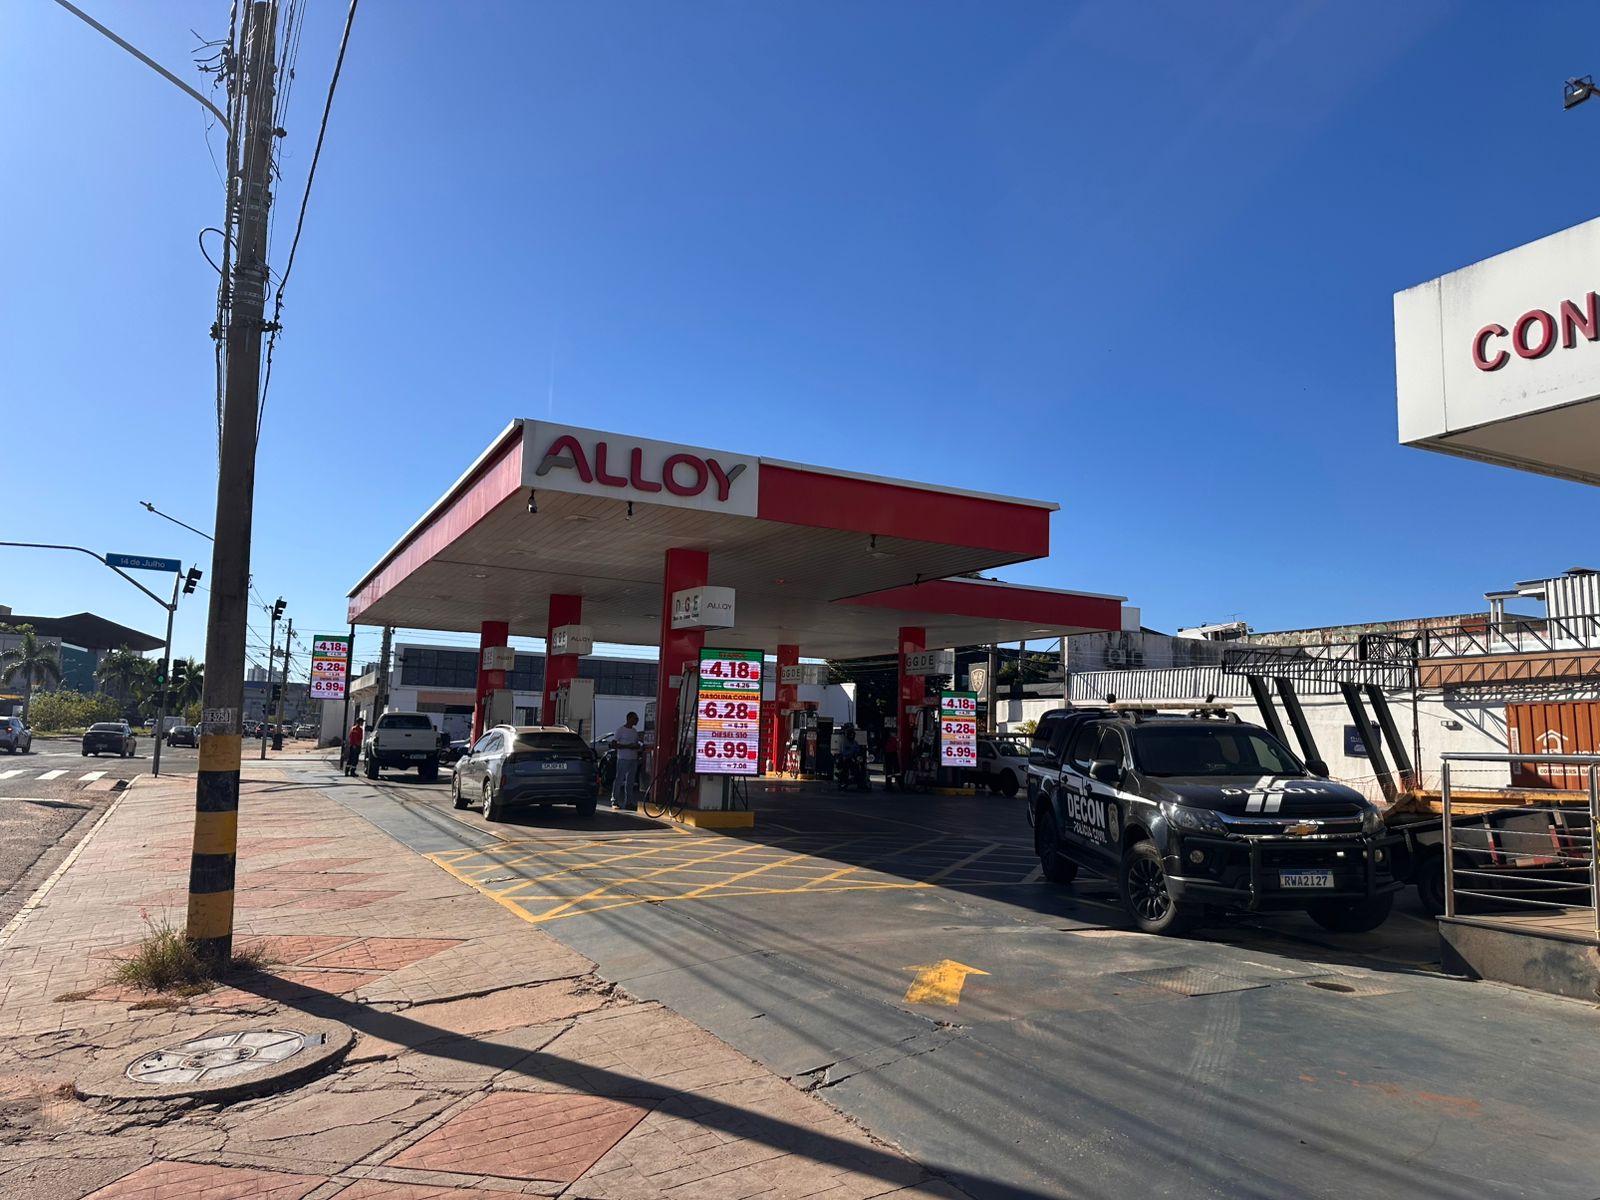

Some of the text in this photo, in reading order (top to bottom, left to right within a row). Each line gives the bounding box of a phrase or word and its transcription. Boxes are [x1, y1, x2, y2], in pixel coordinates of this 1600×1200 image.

[1472, 291, 1600, 372] CON
[535, 435, 748, 502] ALLOY
[120, 557, 166, 568] 14 de Julho
[706, 602, 732, 611] ALLOY
[319, 641, 342, 651] 4.18
[316, 662, 340, 672] 6.28
[709, 661, 750, 679] 4.18
[315, 681, 339, 691] 6.99
[946, 698, 970, 709] 4.18
[704, 701, 749, 719] 6.28
[945, 723, 970, 734] 6.28
[704, 741, 748, 758] 6.99
[945, 746, 971, 757] 6.99
[1221, 786, 1329, 796] DECON
[1066, 792, 1106, 829] DECON
[1284, 875, 1328, 887] RWA2127
